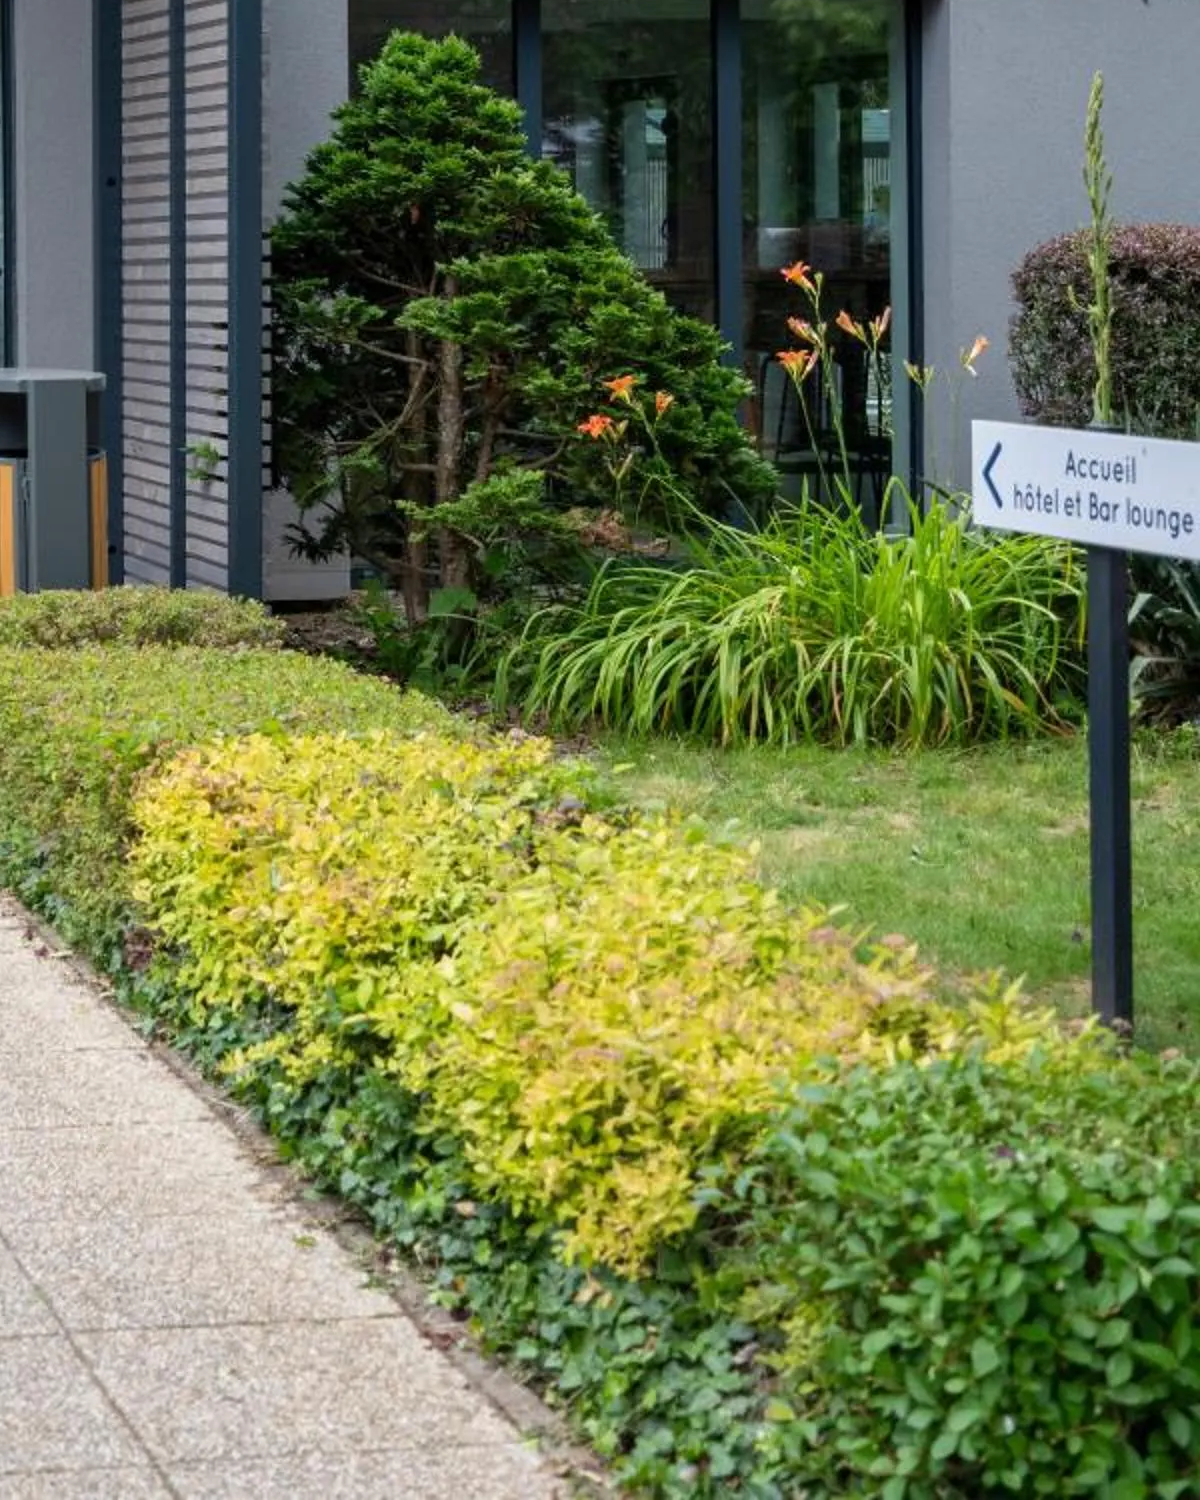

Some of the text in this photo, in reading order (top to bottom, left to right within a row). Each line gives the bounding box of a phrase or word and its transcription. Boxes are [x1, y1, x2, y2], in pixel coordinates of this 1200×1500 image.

[1065, 450, 1137, 484] Accueil
[1013, 483, 1194, 539] hôtel et Bar lounge
